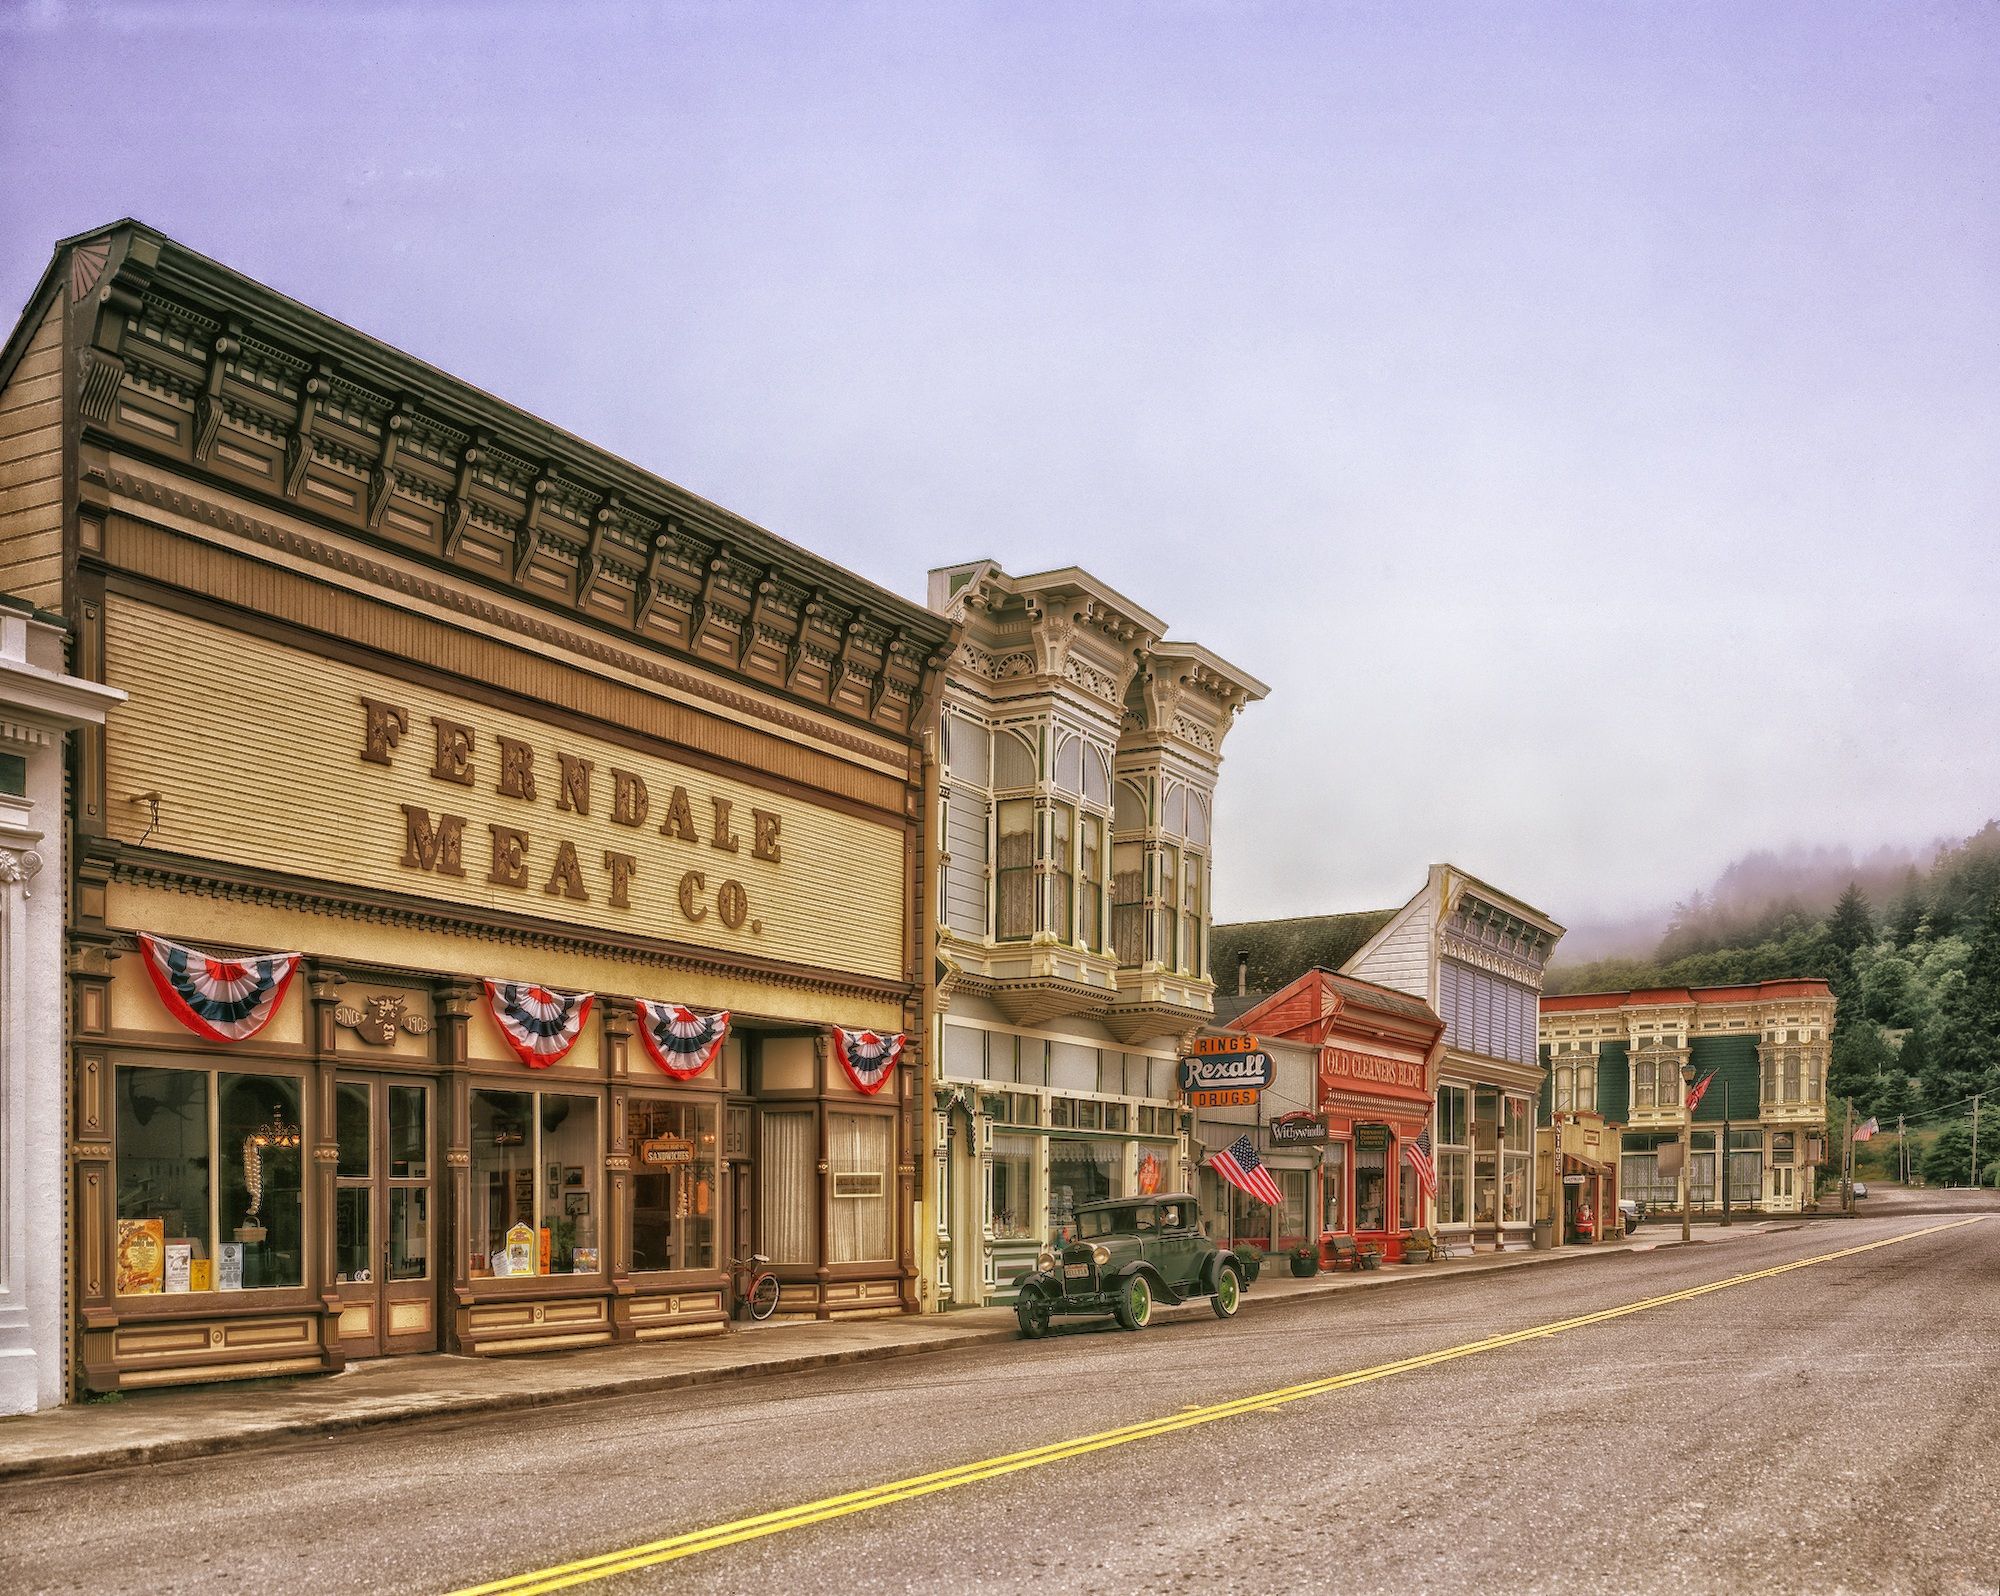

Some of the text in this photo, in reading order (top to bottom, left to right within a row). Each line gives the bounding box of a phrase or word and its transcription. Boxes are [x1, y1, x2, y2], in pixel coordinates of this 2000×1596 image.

[360, 697, 782, 863] FERNDALE
[399, 803, 763, 934] MEAT CO.
[335, 1008, 428, 1032] SINCE 1903
[1200, 1037, 1251, 1052] RING'S
[1184, 1054, 1266, 1089] Rexall
[1327, 1049, 1420, 1089] OLD CLEANERS BLDG
[1200, 1092, 1251, 1106] DRUGS
[1271, 1122, 1327, 1141] Withywindle
[648, 1150, 690, 1161] SANDWICHES
